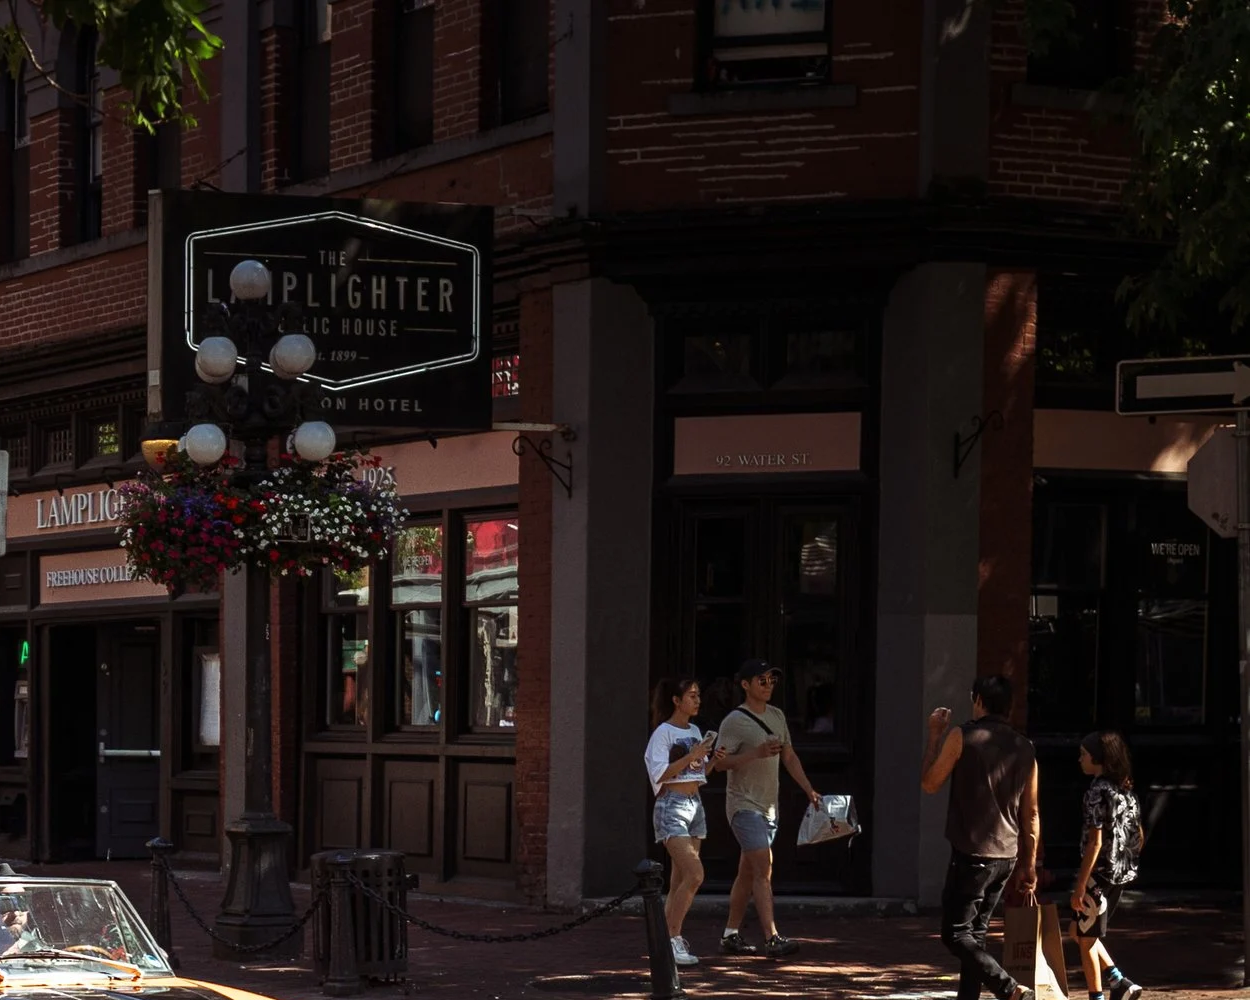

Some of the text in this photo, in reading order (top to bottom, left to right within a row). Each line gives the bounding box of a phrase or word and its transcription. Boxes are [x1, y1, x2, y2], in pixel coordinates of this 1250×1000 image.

[319, 250, 348, 267] THE
[207, 269, 454, 313] LPLIGHTER
[342, 317, 398, 337] HOUSE
[330, 350, 358, 361] 1899
[359, 398, 424, 413] HOTEL
[716, 455, 731, 466] 92
[738, 453, 786, 466] WATER
[1150, 542, 1201, 556] WE'RE OPEN
[46, 566, 99, 588] FREEHOUSE
